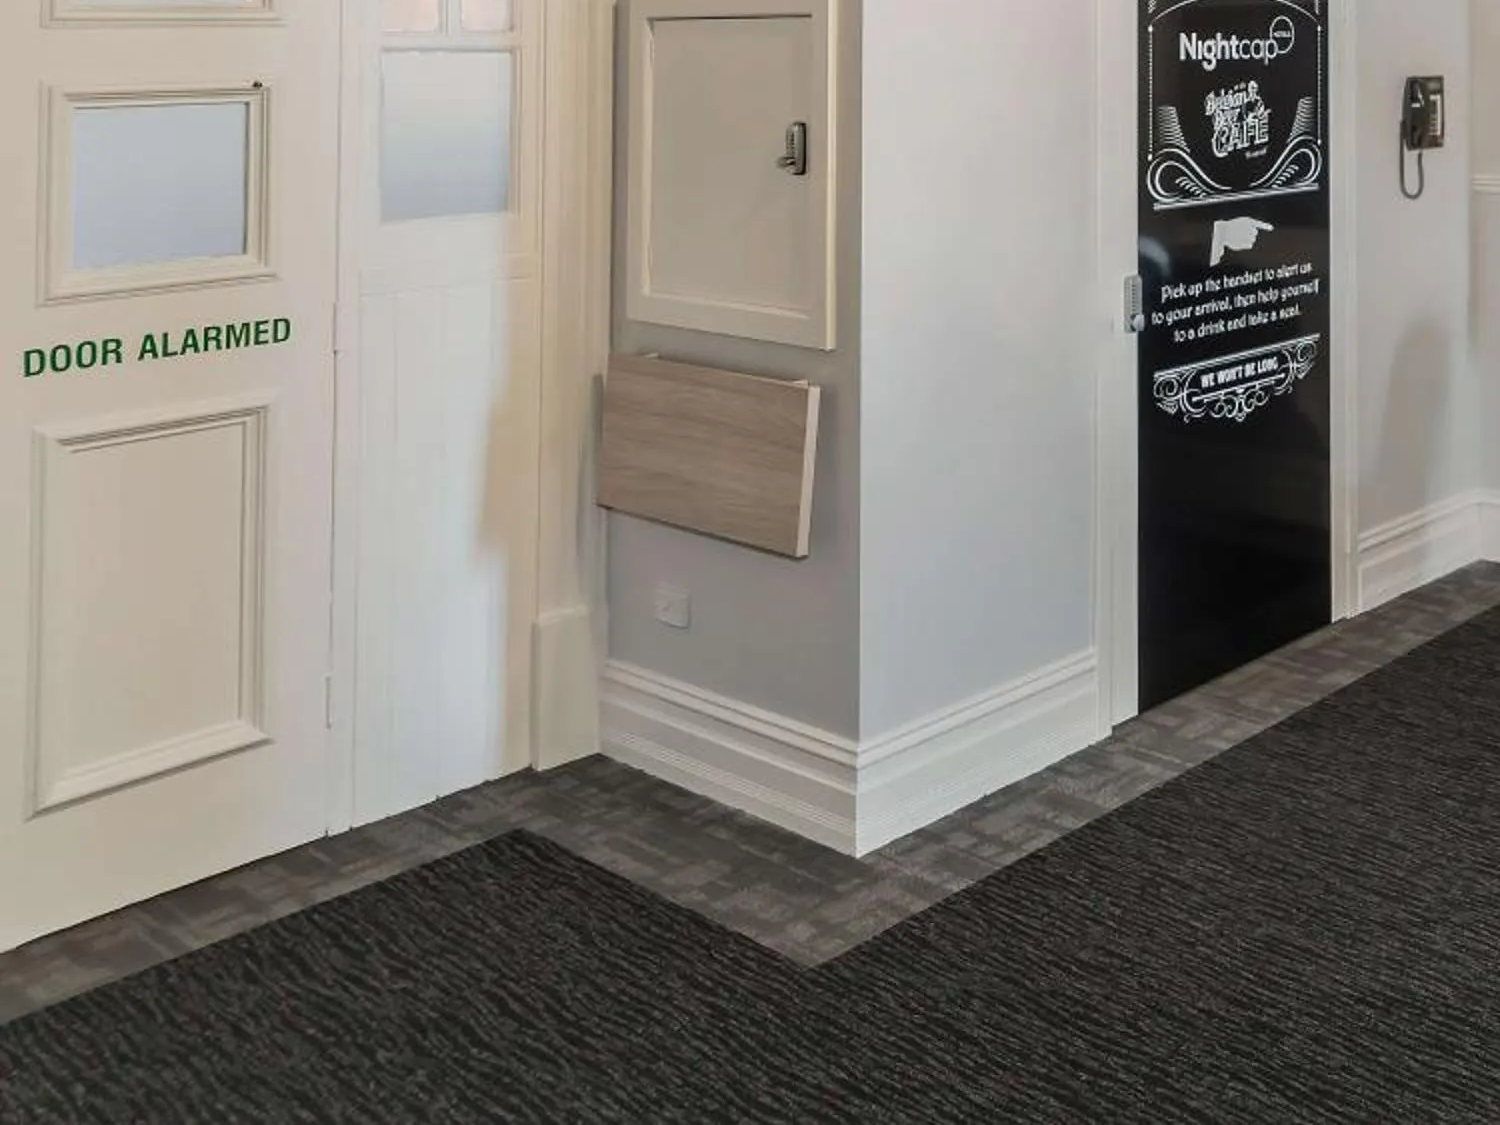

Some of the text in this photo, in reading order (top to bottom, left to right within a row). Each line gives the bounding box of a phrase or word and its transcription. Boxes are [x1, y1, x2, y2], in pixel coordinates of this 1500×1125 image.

[1179, 32, 1278, 71] Nightcap
[1161, 283, 1187, 304] Pick
[1188, 283, 1203, 298] up
[1151, 312, 1164, 325] to
[1166, 307, 1193, 326] your
[1174, 329, 1187, 343] to
[23, 318, 292, 377] DOOR ALARMED
